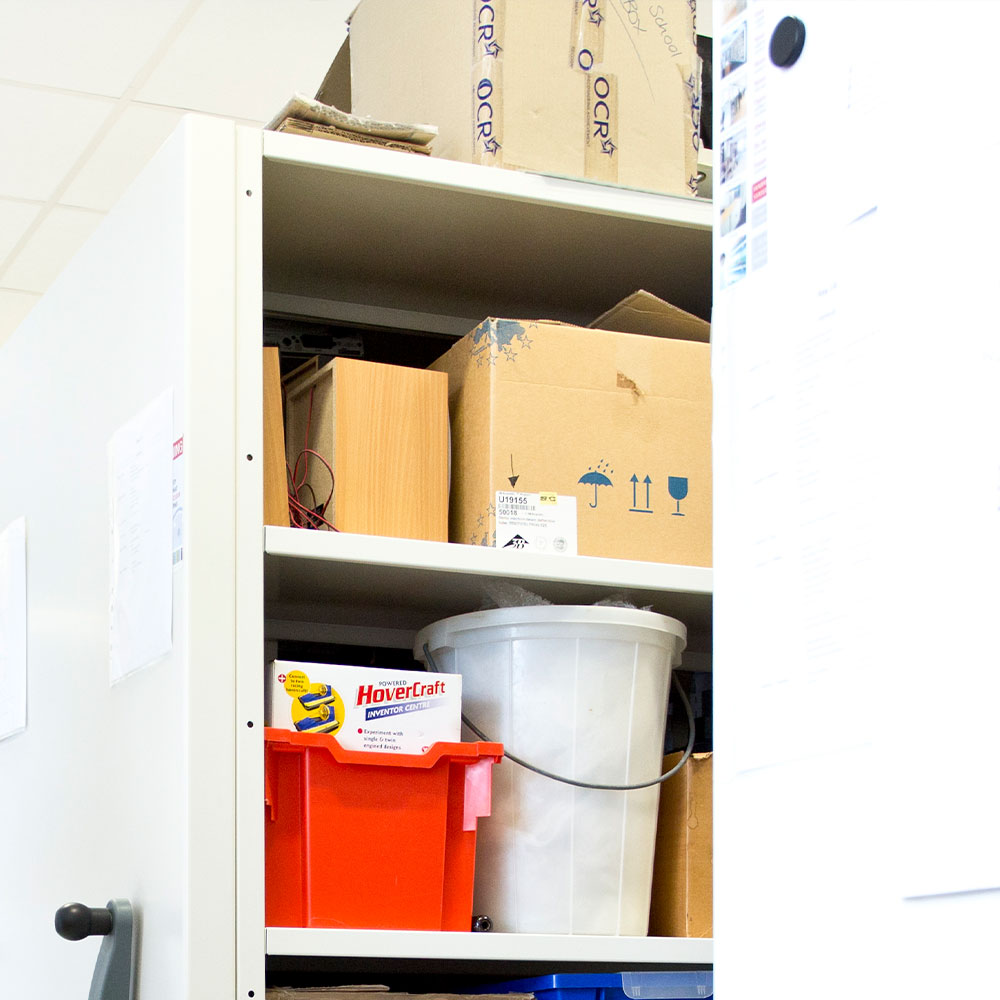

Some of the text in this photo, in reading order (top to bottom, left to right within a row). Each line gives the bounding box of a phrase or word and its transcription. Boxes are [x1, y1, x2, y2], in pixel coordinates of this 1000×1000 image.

[478, 0, 495, 43] CR
[649, 5, 683, 58] School
[476, 78, 493, 141] OCR
[593, 76, 610, 138] OCR
[356, 681, 446, 706] HoverCraft
[367, 702, 430, 718] INVENTOR CENTRE
[364, 729, 391, 737] Experiment
